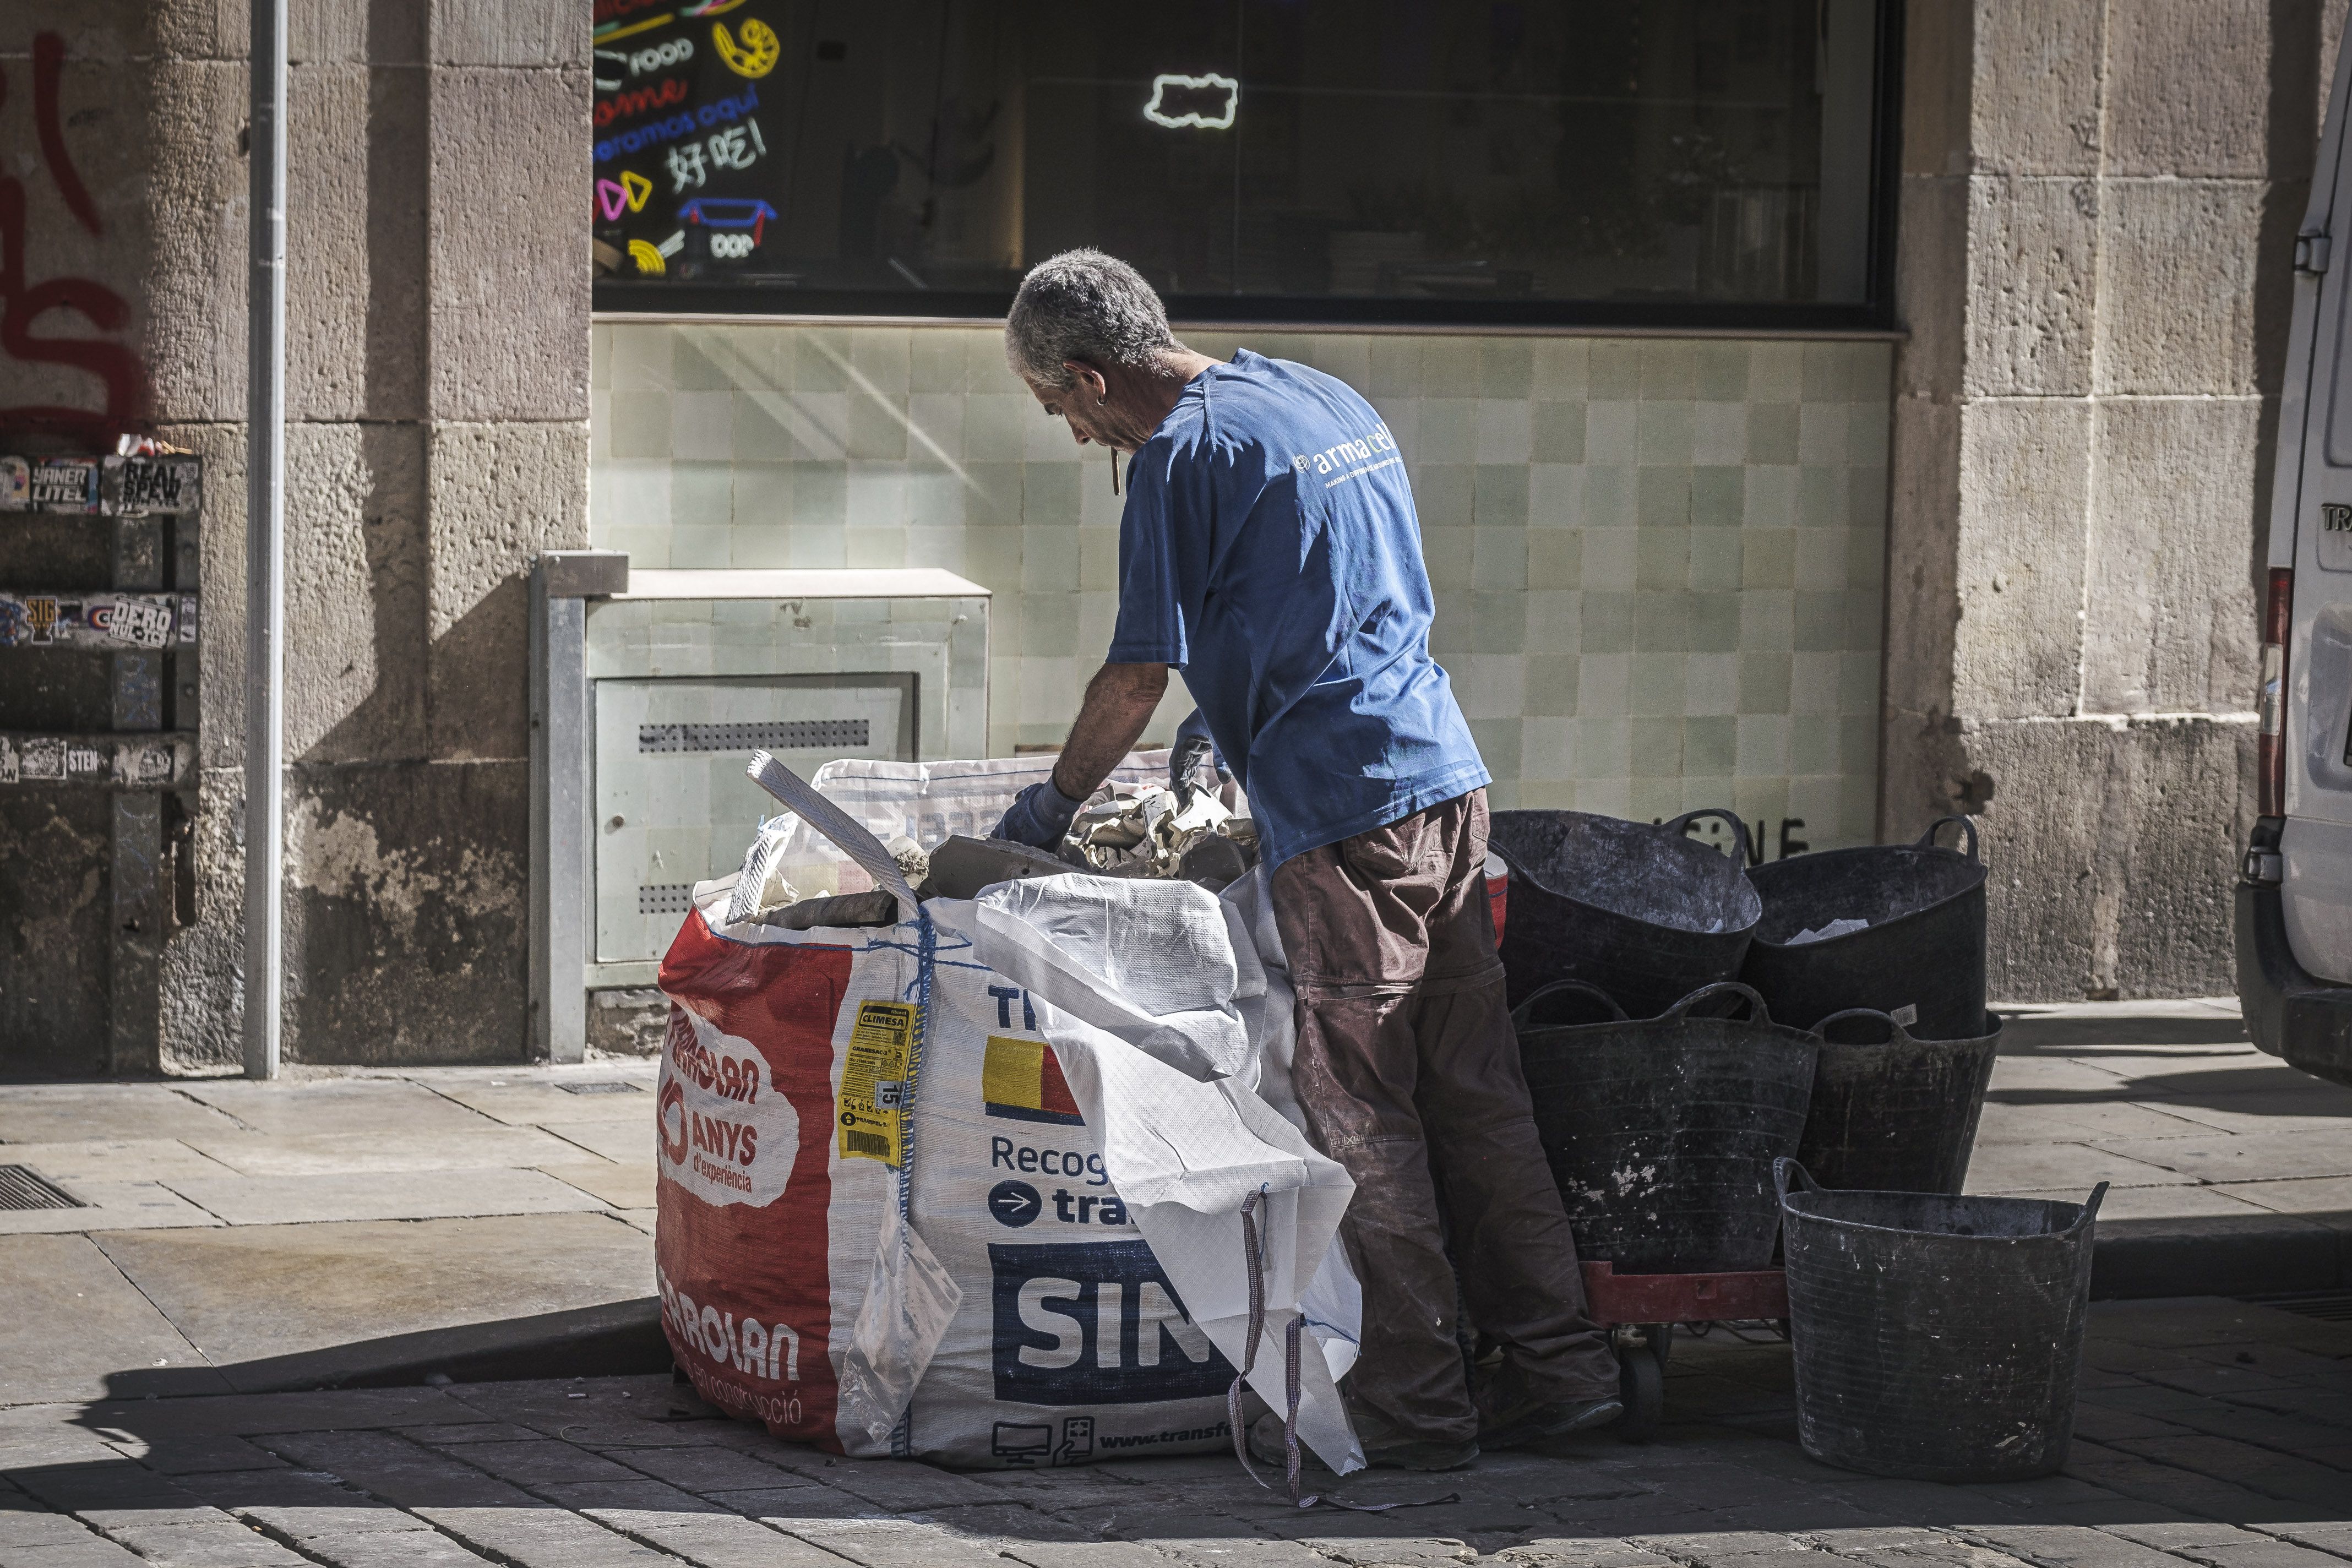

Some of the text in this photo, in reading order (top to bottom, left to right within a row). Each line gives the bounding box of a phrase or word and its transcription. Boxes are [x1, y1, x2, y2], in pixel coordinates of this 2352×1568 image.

[862, 1014, 905, 1027] CLIMESA
[882, 1085, 900, 1104] 15
[692, 1110, 758, 1166] ANYS
[694, 1151, 752, 1194] d'experiència
[992, 1136, 1109, 1186] Recog
[1052, 1188, 1137, 1226] tra
[1018, 1277, 1210, 1369] SIN
